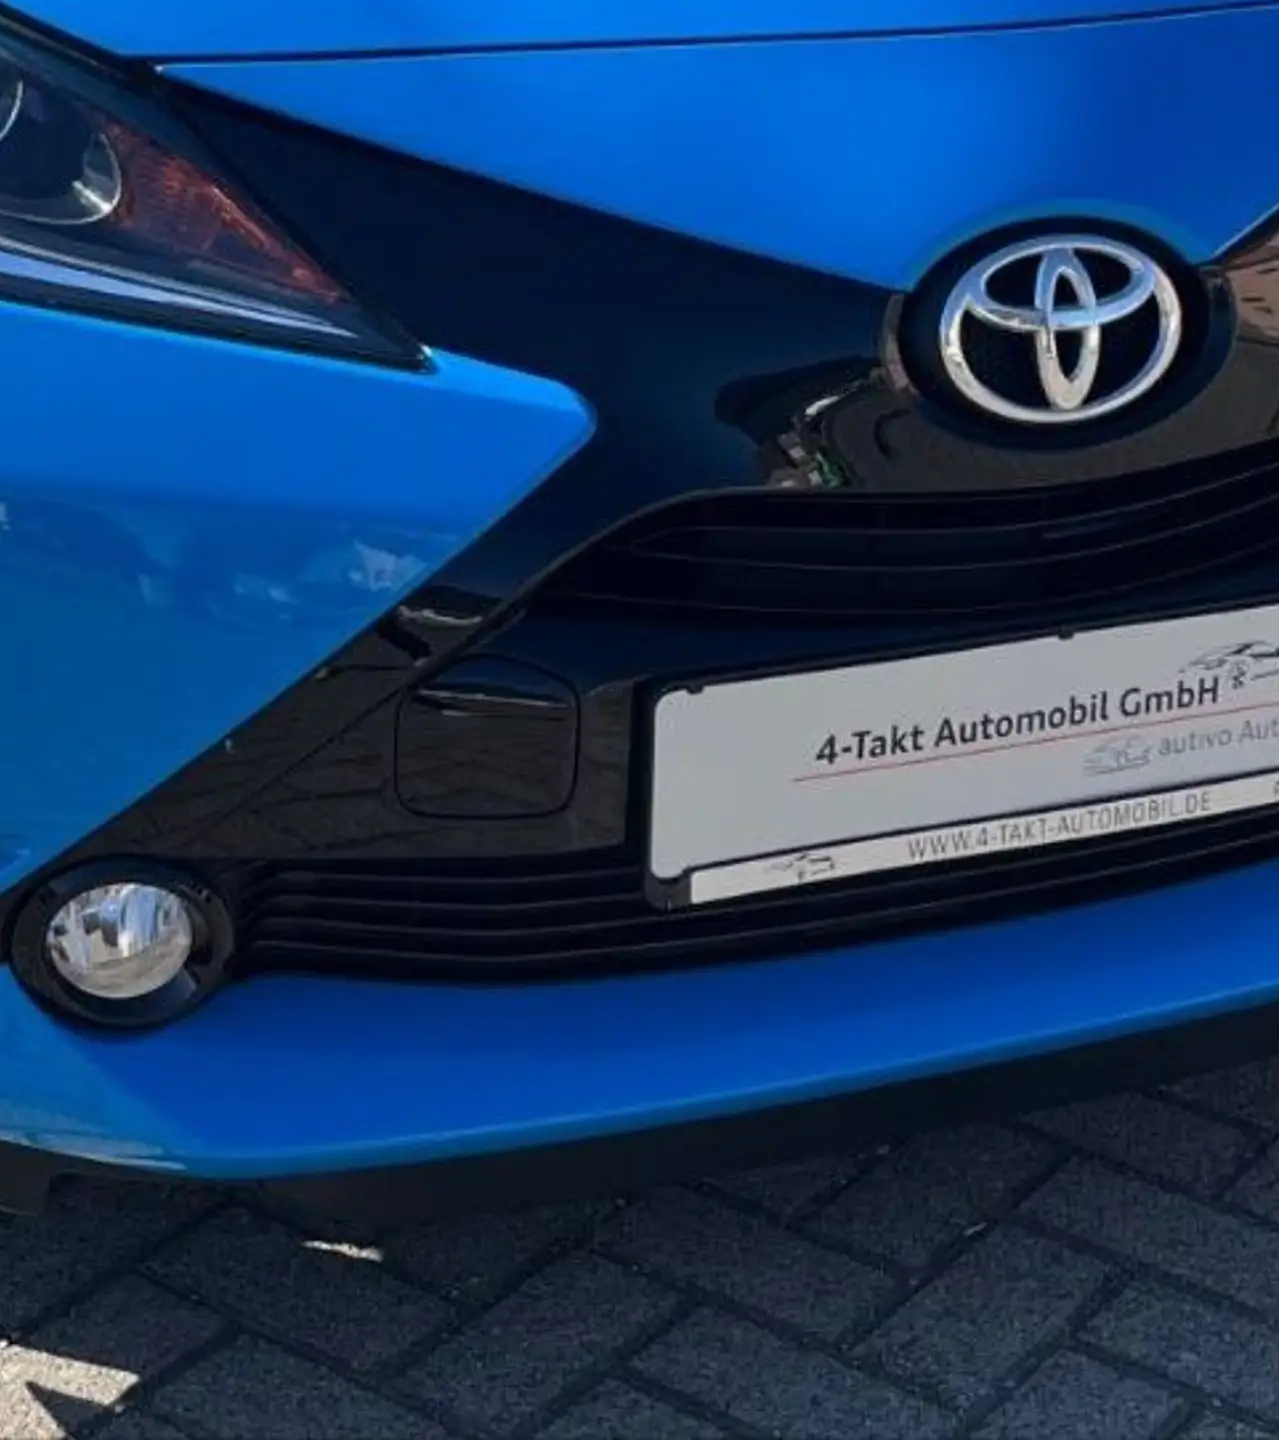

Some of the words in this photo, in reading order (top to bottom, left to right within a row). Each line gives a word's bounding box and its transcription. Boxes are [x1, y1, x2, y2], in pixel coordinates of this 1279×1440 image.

[815, 725, 925, 765] 4-Takt
[933, 691, 1110, 748] Automobil
[1119, 675, 1220, 718] GmbH
[1157, 726, 1233, 756] autivo
[906, 791, 1213, 861] WWW.4-TAKT-AUTOMOBIL.DE
